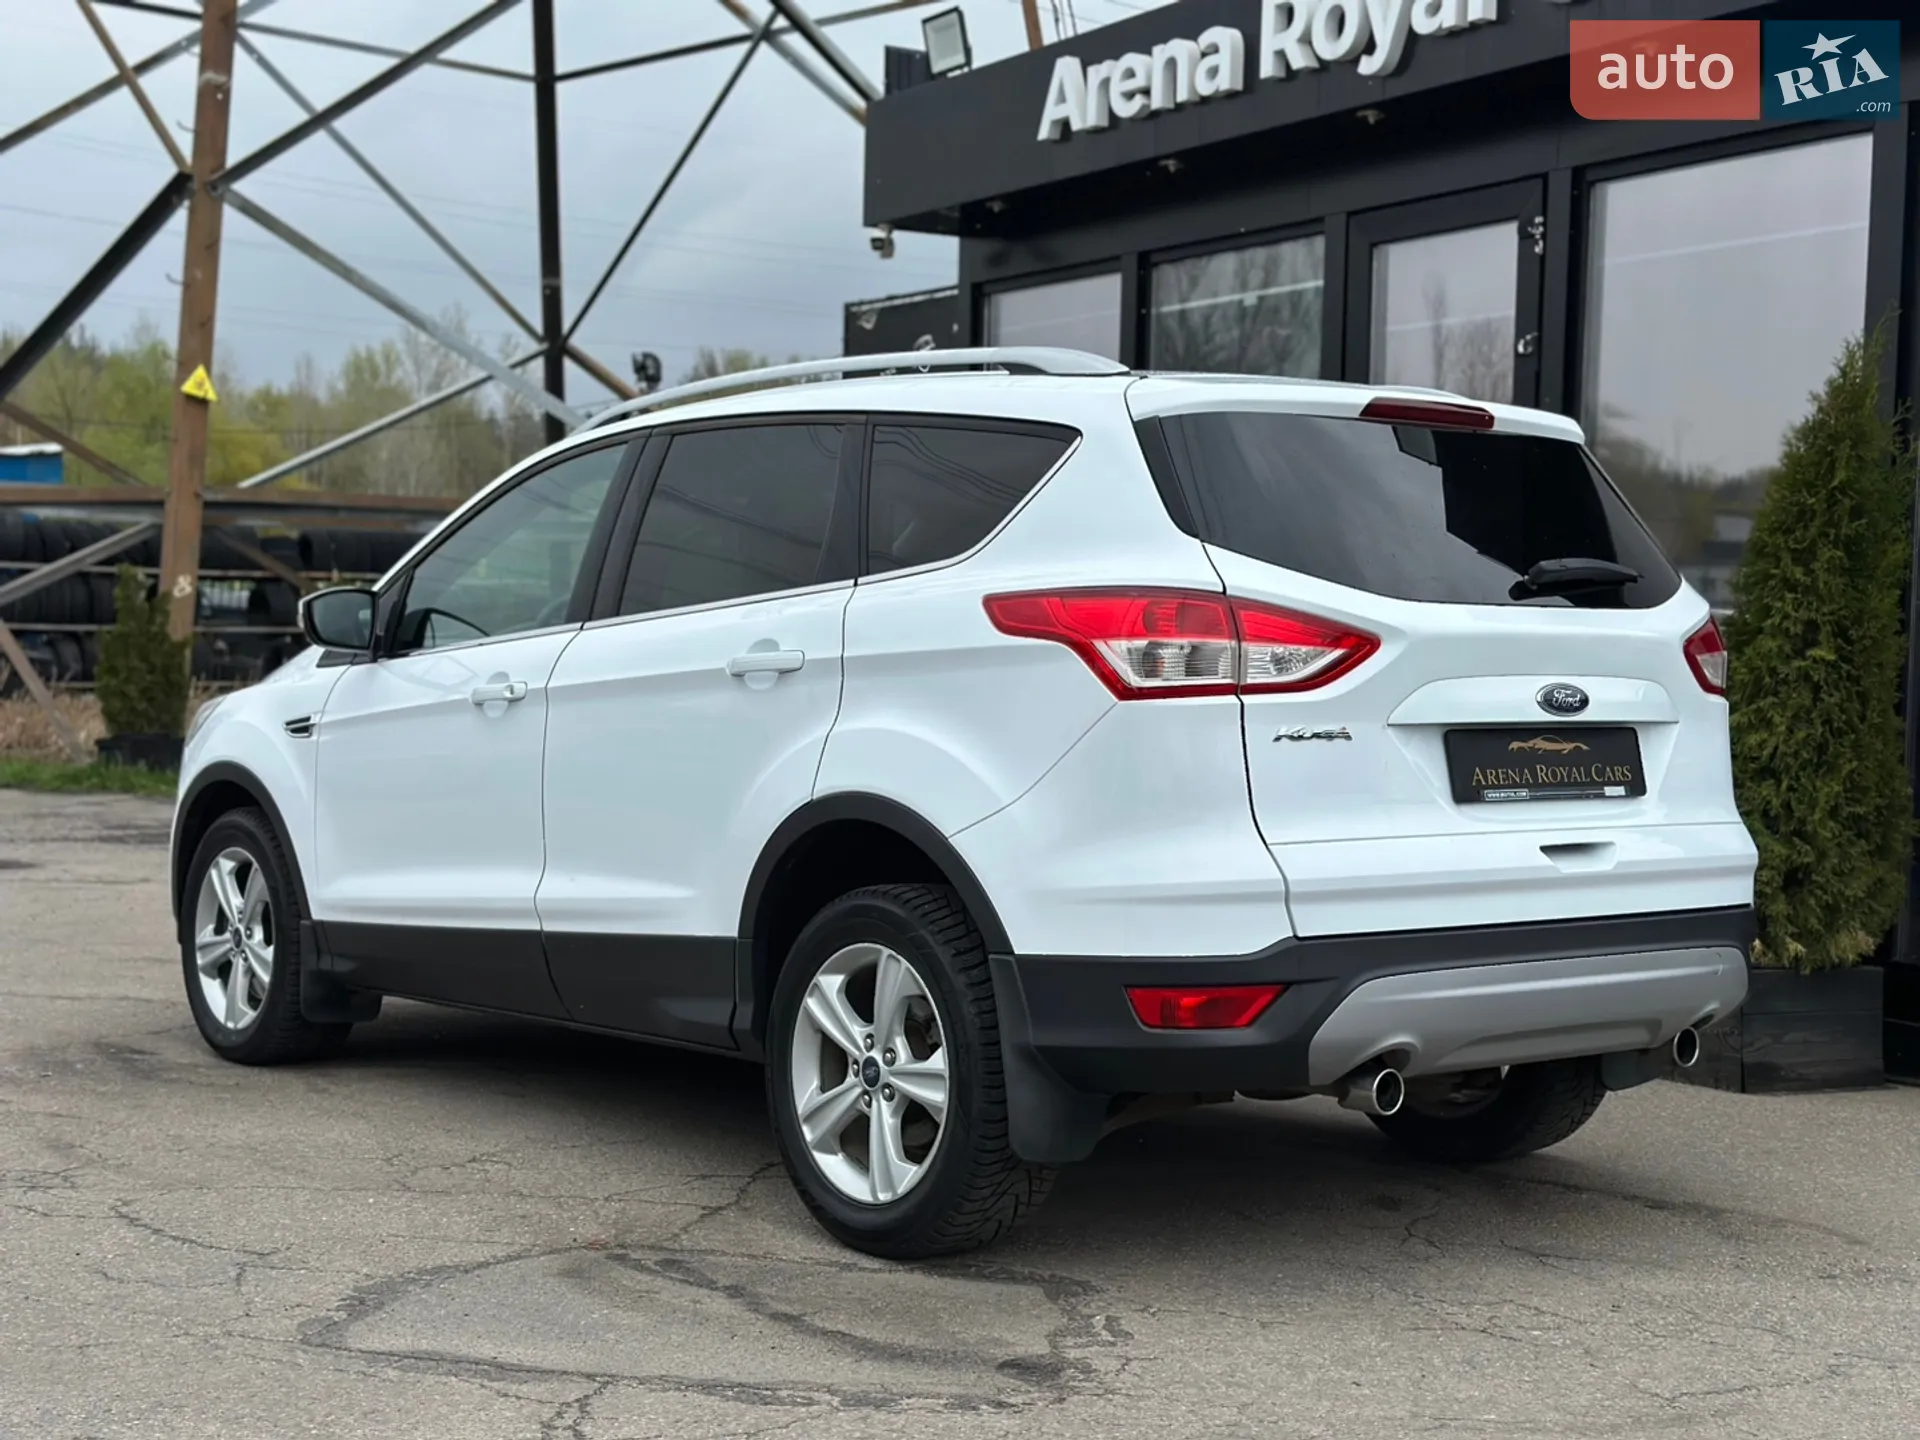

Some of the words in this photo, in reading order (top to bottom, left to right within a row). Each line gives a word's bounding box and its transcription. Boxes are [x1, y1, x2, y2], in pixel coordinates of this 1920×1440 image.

[1037, 25, 1244, 141] Arena
[1259, 0, 1497, 79] Roya
[1552, 689, 1581, 707] Ford
[1472, 767, 1533, 786] ARENA
[1536, 764, 1590, 783] ROYAL
[1591, 763, 1632, 782] CARS
